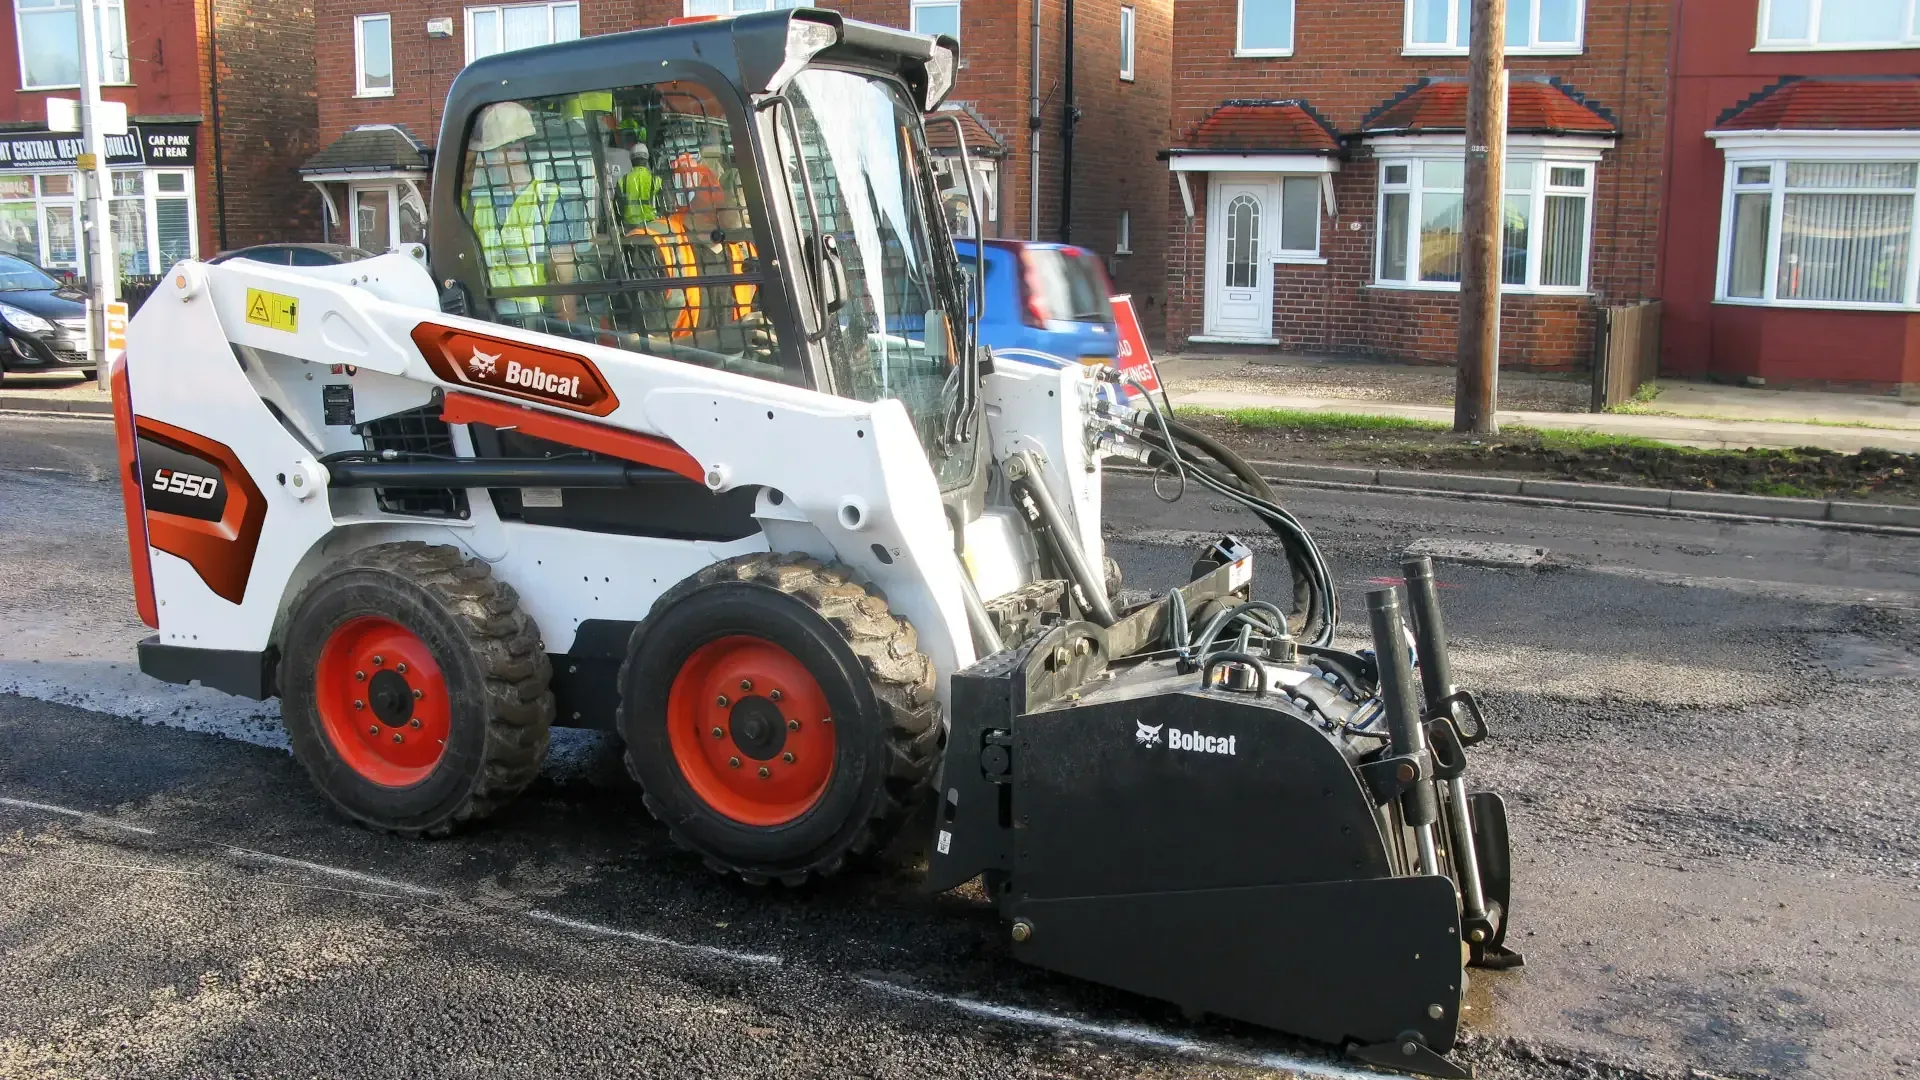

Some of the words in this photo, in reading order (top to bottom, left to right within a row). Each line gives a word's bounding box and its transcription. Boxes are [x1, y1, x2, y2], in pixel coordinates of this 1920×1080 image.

[12, 140, 58, 160] CENTRAL
[56, 138, 85, 159] HEAT
[148, 135, 166, 146] CAR
[167, 135, 190, 146] PARK
[153, 147, 164, 157] AT
[166, 147, 188, 157] REAR
[505, 360, 580, 398] Bobcat
[152, 468, 218, 499] S550
[1168, 727, 1236, 756] Bobcat
